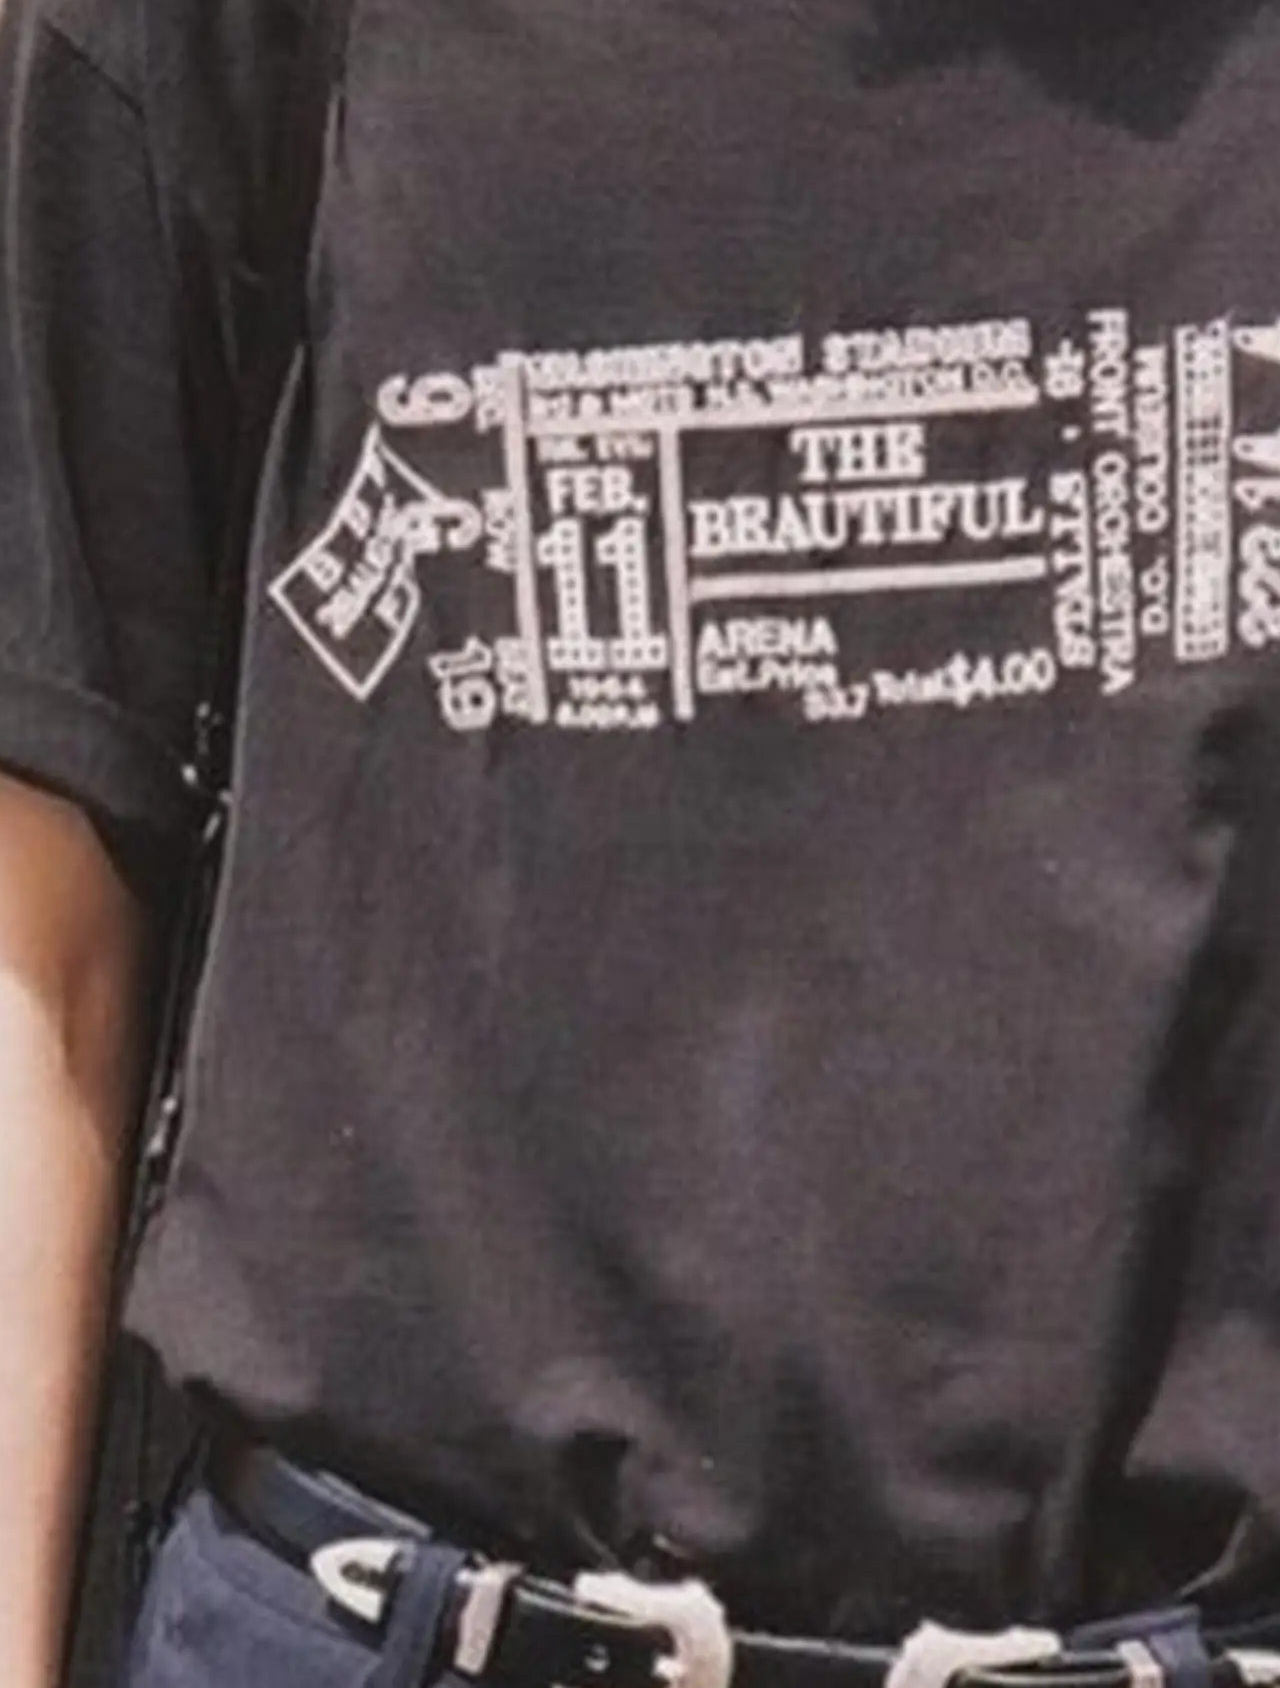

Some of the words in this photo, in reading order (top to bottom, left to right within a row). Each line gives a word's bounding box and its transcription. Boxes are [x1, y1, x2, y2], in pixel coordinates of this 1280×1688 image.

[1086, 308, 1130, 439] FRONT
[546, 464, 649, 514] FEB.
[789, 423, 925, 482] THE
[690, 478, 1046, 557] BEAUTIFUL
[536, 517, 667, 670] 11
[1091, 451, 1136, 696] ORCHESTRA
[697, 616, 838, 658] ARENA
